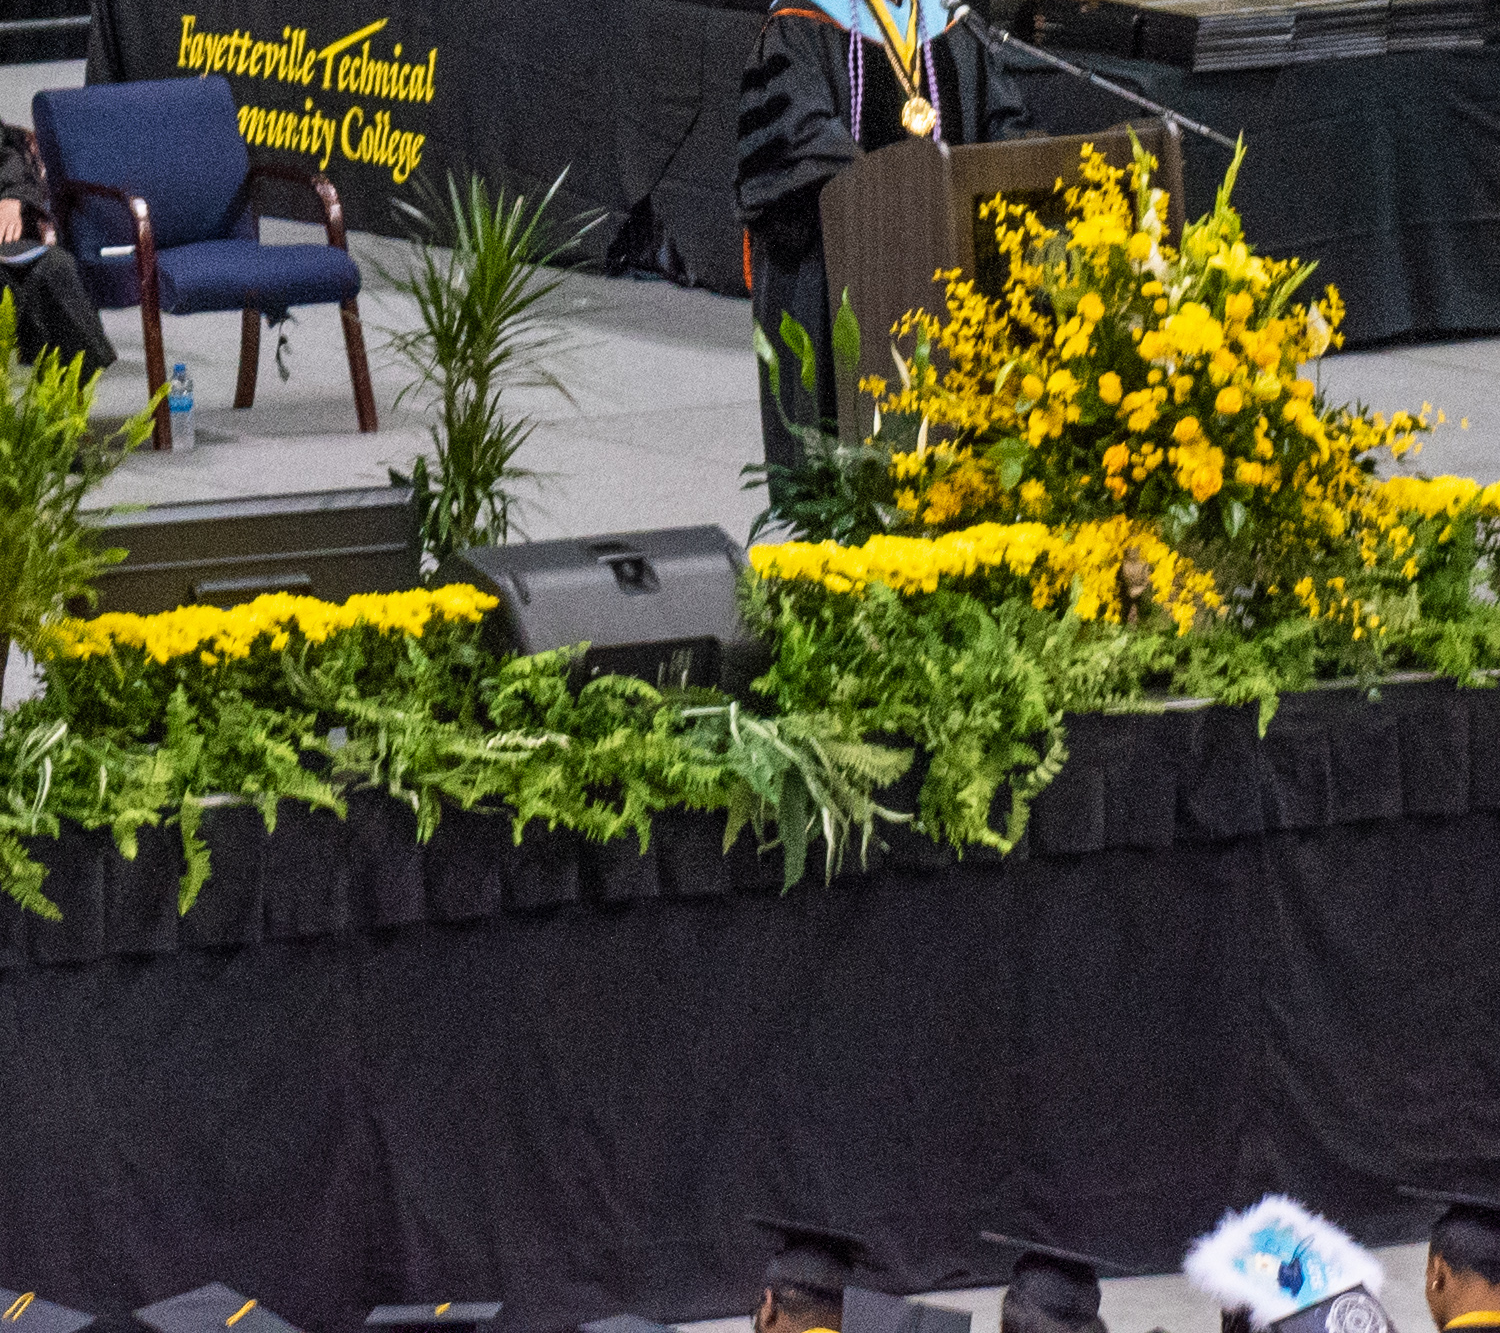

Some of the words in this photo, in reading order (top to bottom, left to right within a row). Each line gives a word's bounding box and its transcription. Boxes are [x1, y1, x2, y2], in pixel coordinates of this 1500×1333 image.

[177, 14, 317, 85] Fayetteville
[317, 17, 438, 103] Technical
[237, 96, 337, 171] munity
[341, 105, 426, 185] College
